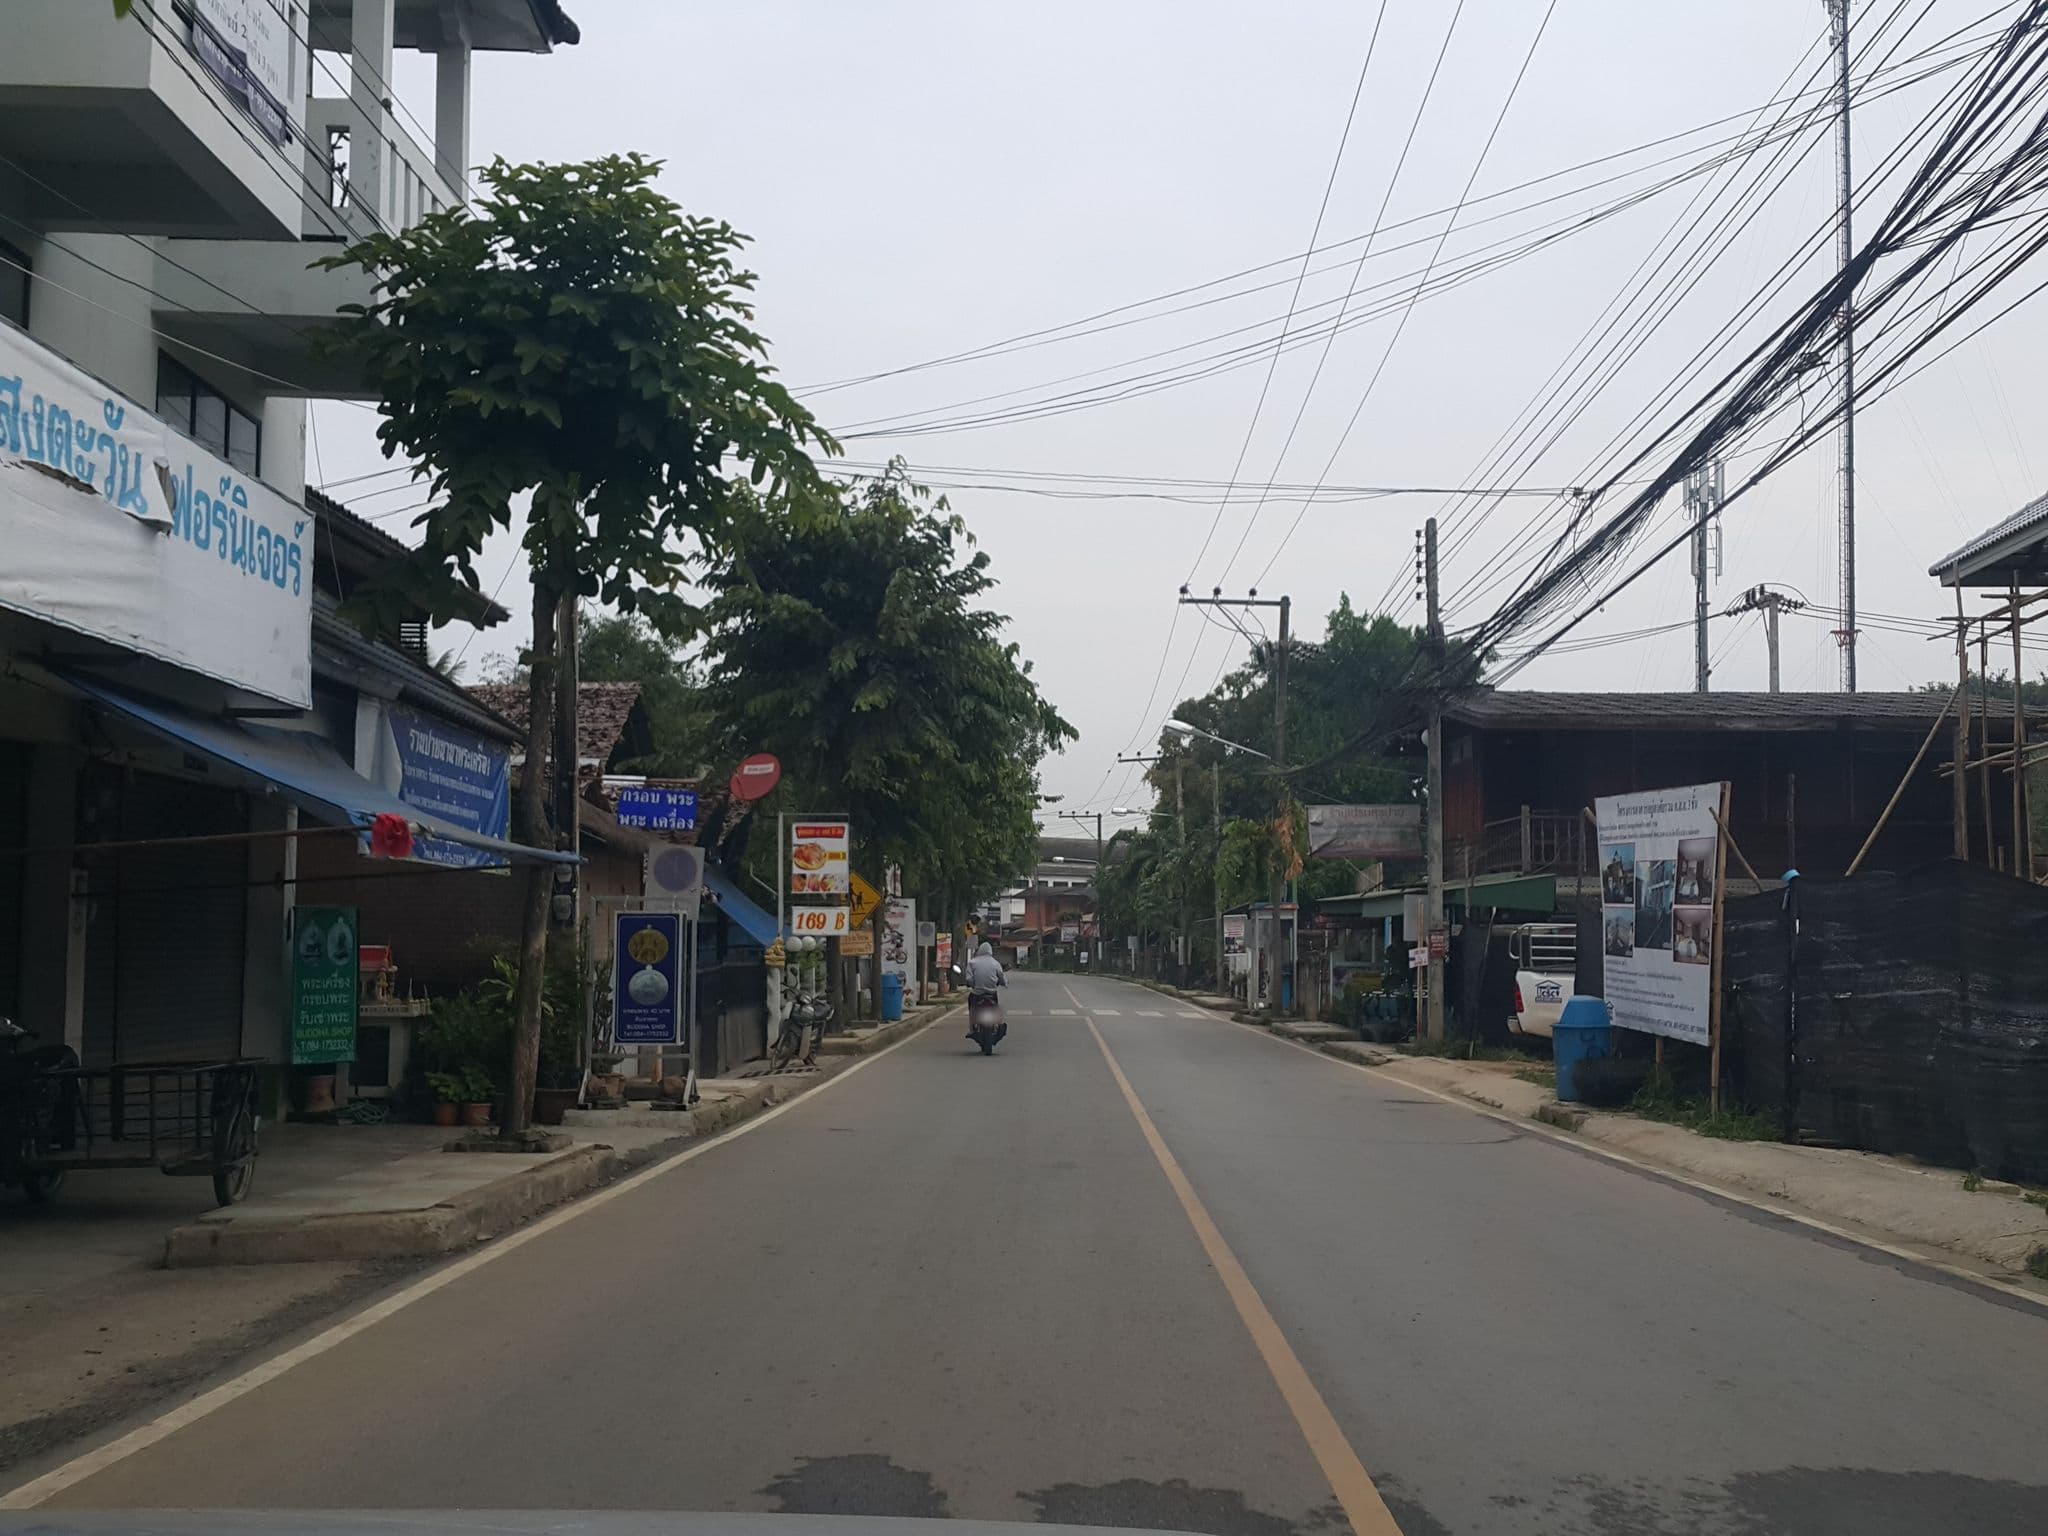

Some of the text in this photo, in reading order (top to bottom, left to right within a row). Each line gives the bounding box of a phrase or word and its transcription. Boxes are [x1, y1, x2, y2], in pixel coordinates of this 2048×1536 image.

[241, 24, 249, 39] 2
[623, 790, 695, 806] กรอบ พระ
[618, 808, 695, 830] พระ เครื่อง
[795, 911, 827, 930] 169
